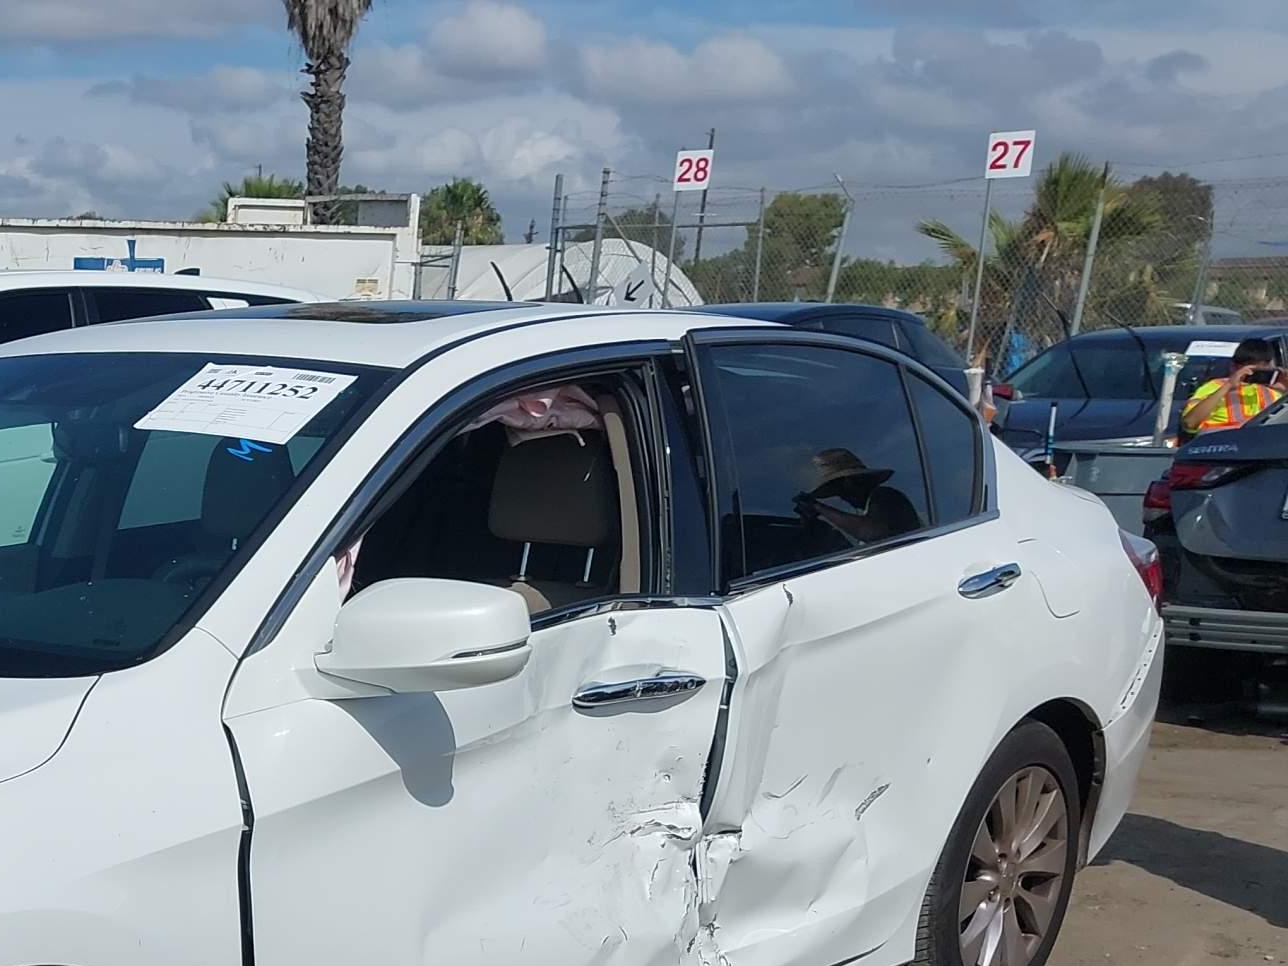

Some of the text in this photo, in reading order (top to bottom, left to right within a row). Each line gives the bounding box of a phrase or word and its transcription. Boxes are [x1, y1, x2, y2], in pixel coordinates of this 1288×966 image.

[989, 139, 1032, 171] 27
[677, 157, 709, 183] 28
[197, 378, 319, 400] 44711252
